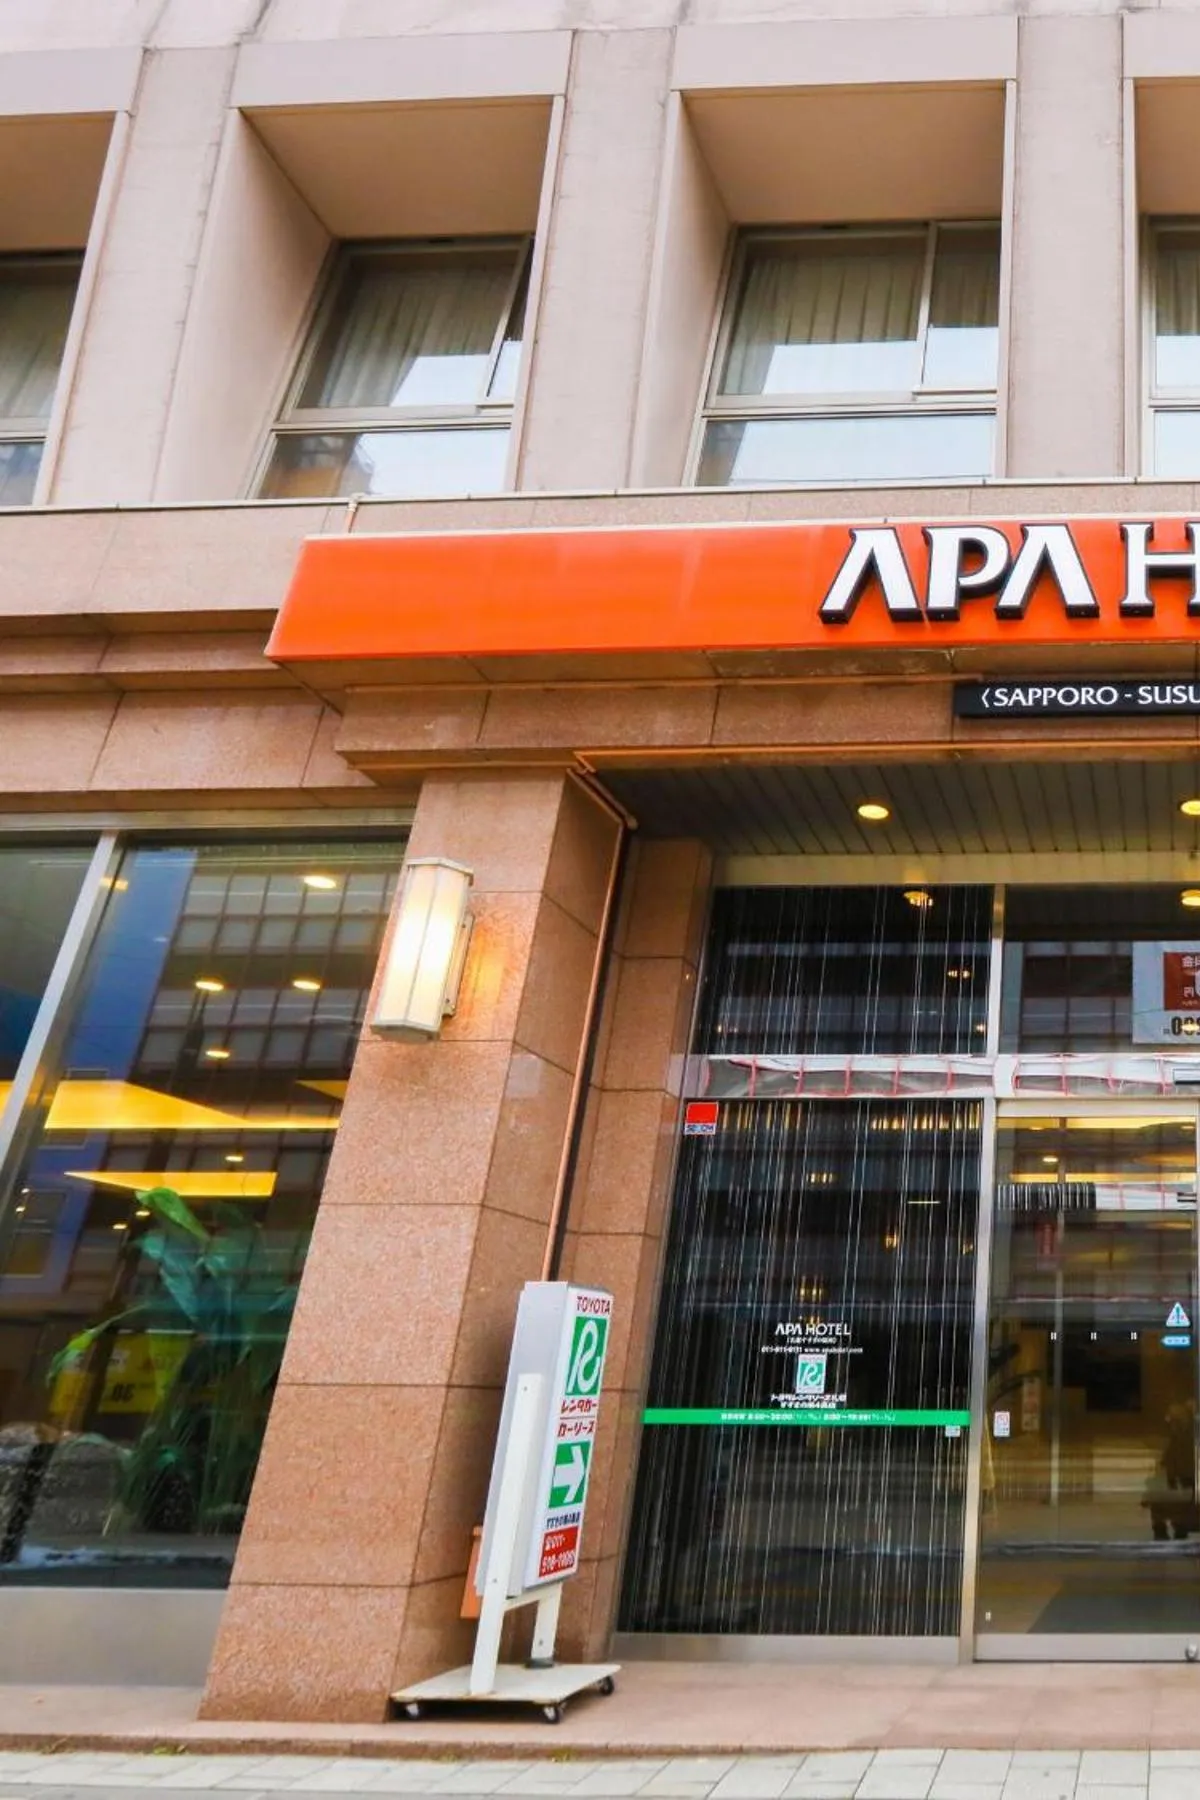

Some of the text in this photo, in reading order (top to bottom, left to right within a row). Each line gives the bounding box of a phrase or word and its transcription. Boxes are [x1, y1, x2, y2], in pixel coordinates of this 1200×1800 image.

[818, 524, 1101, 624] APA
[576, 1295, 611, 1315] TOYOTA
[775, 1323, 852, 1336] APA HOTEL
[560, 1397, 598, 1415] レンタカー
[557, 1420, 595, 1438] カーリース
